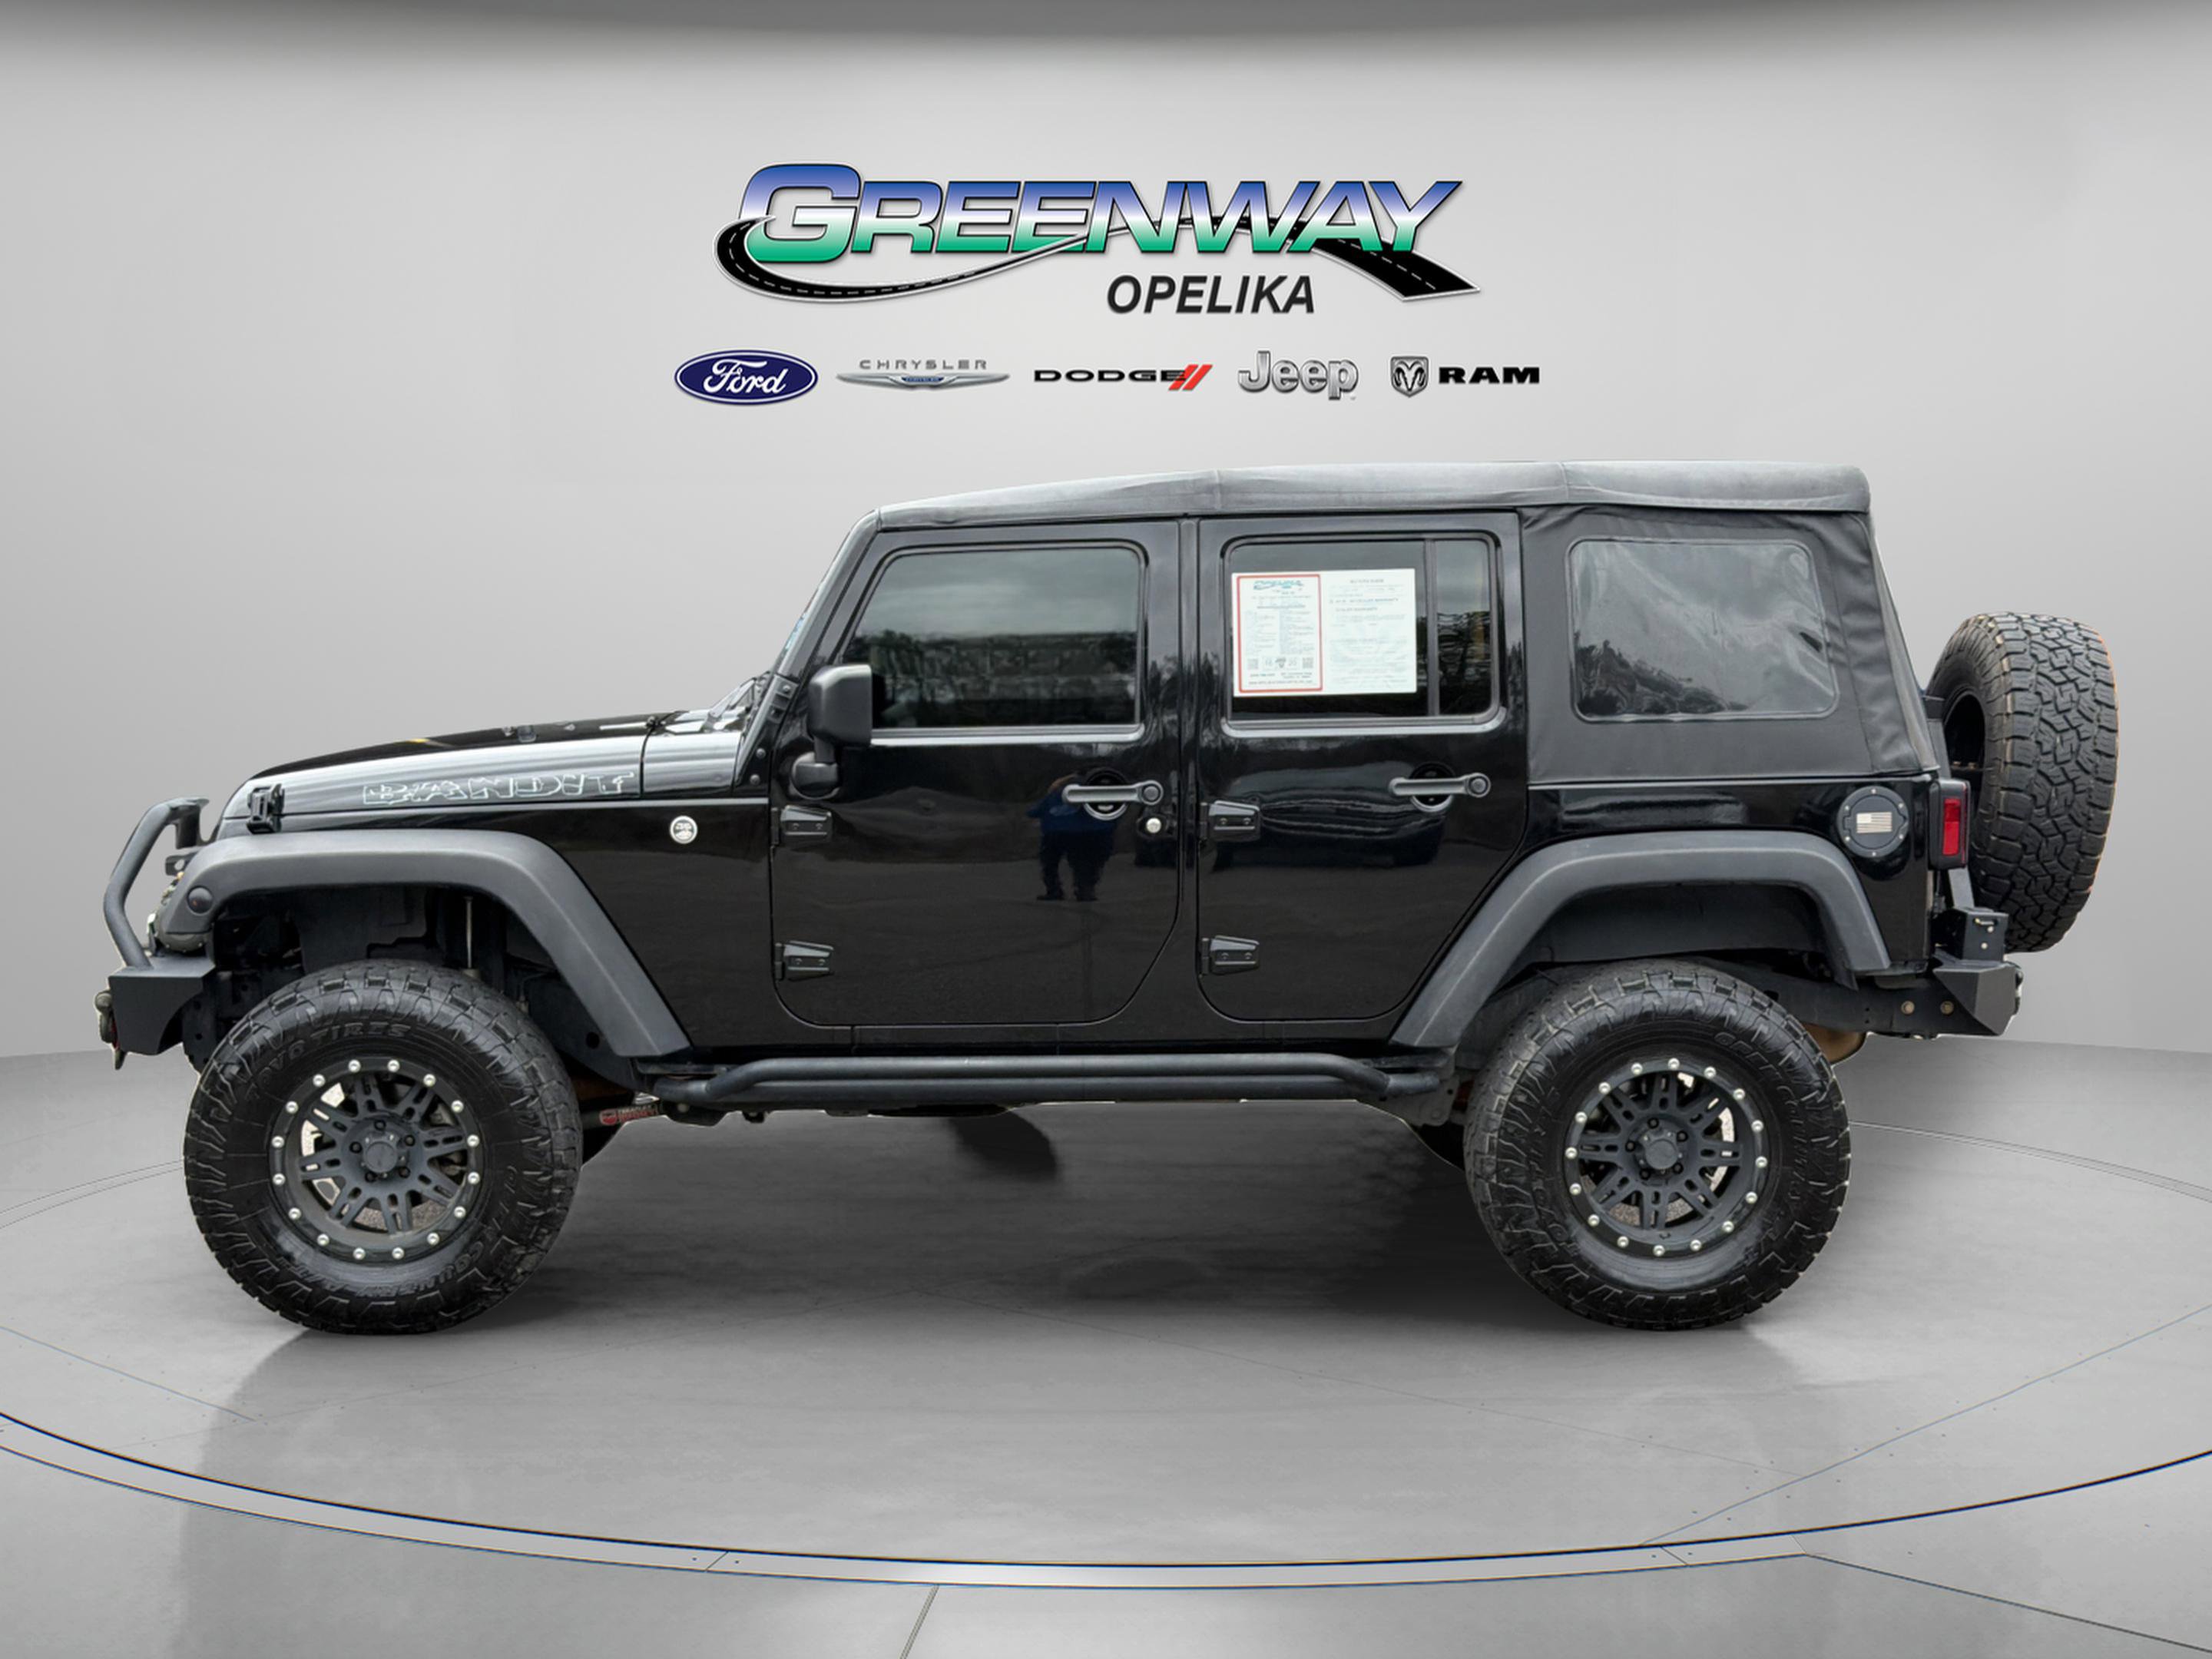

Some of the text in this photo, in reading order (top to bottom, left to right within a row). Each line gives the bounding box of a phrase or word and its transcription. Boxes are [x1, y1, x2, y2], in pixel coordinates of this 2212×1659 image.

[737, 163, 1463, 264] GREENWAY
[1106, 274, 1315, 316] OPELIKA
[703, 359, 788, 394] Ford
[859, 359, 988, 371] CHRYSLER
[1034, 369, 1187, 382] DODGE
[1237, 350, 1359, 400] Jeep
[1439, 366, 1540, 384] RAM
[310, 1021, 412, 1045] TIRES
